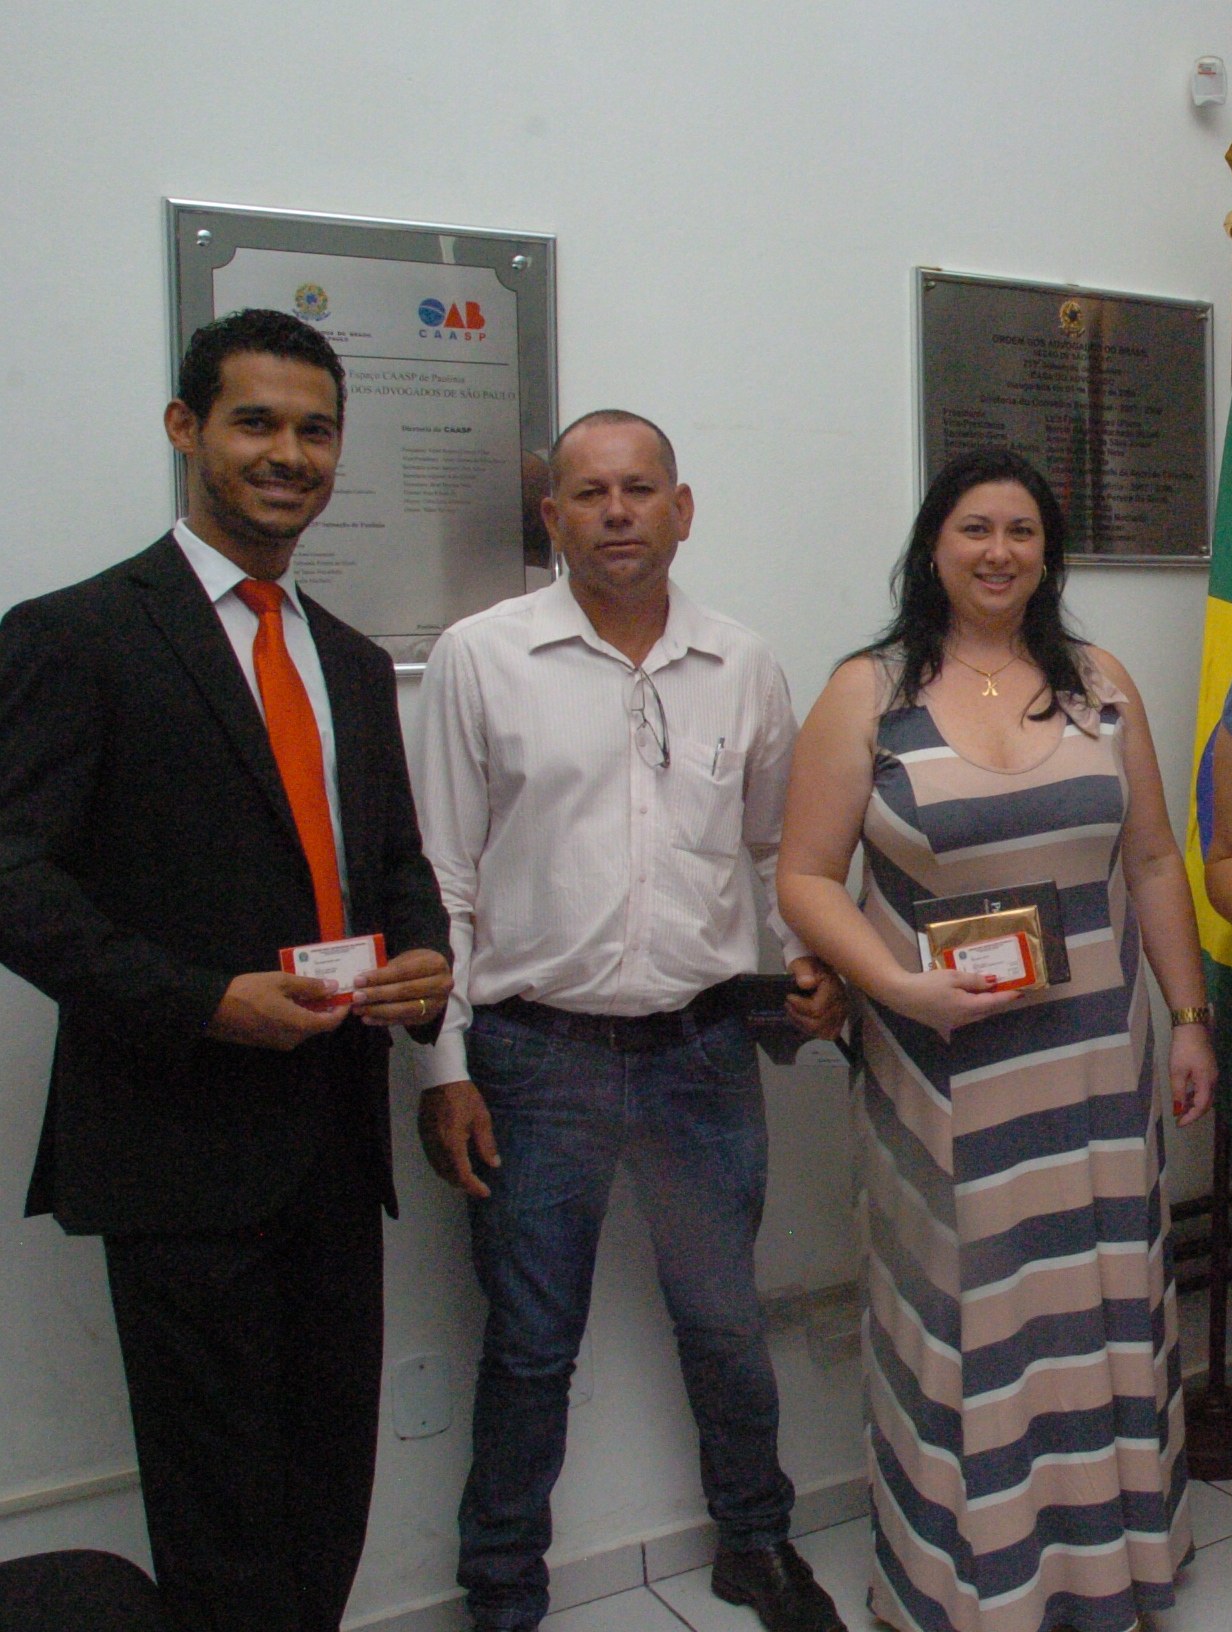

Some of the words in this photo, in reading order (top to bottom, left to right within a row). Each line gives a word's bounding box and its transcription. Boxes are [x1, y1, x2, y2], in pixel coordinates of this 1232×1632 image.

[418, 298, 486, 330] OAB
[351, 386, 372, 394] DOS
[375, 386, 441, 397] ADVOGADOS
